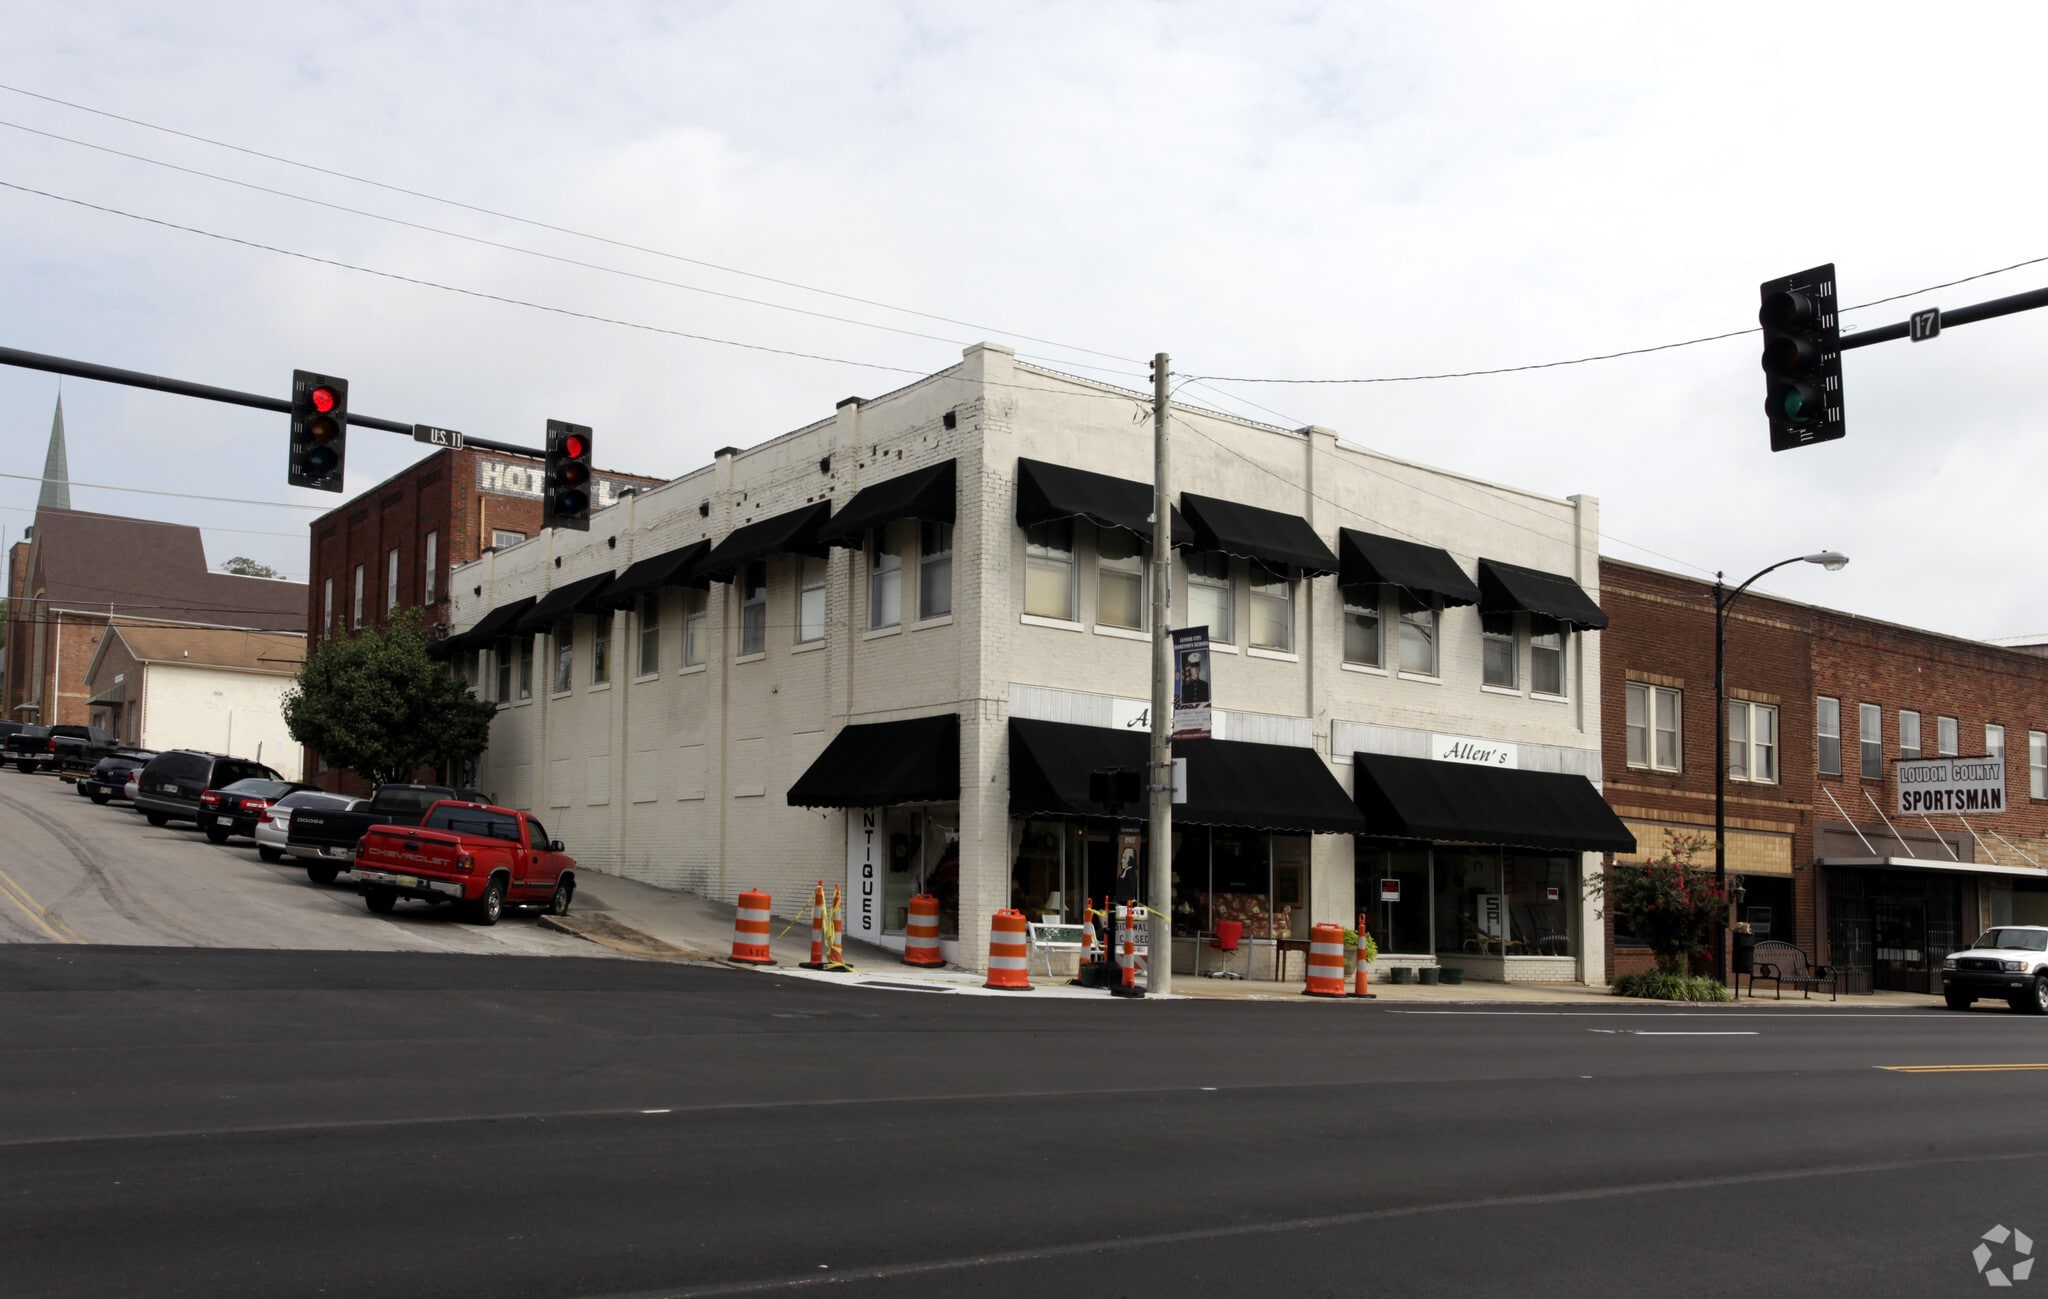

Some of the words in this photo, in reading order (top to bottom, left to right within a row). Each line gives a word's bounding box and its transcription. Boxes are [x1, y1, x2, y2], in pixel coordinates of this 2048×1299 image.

[1914, 312, 1935, 338] 17
[431, 429, 449, 445] U.S.
[452, 432, 461, 448] 11
[481, 461, 546, 496] HOT
[1443, 742, 1508, 764] Allen's
[1900, 766, 1947, 783] LOUDON
[1952, 763, 2001, 781] COUNTY
[1902, 788, 2002, 811] SPORTSMAN
[368, 847, 452, 866] CHEVROLET
[862, 811, 875, 931] NTIQUES
[1486, 897, 1501, 938] SAL
[1119, 935, 1149, 944] CSED
